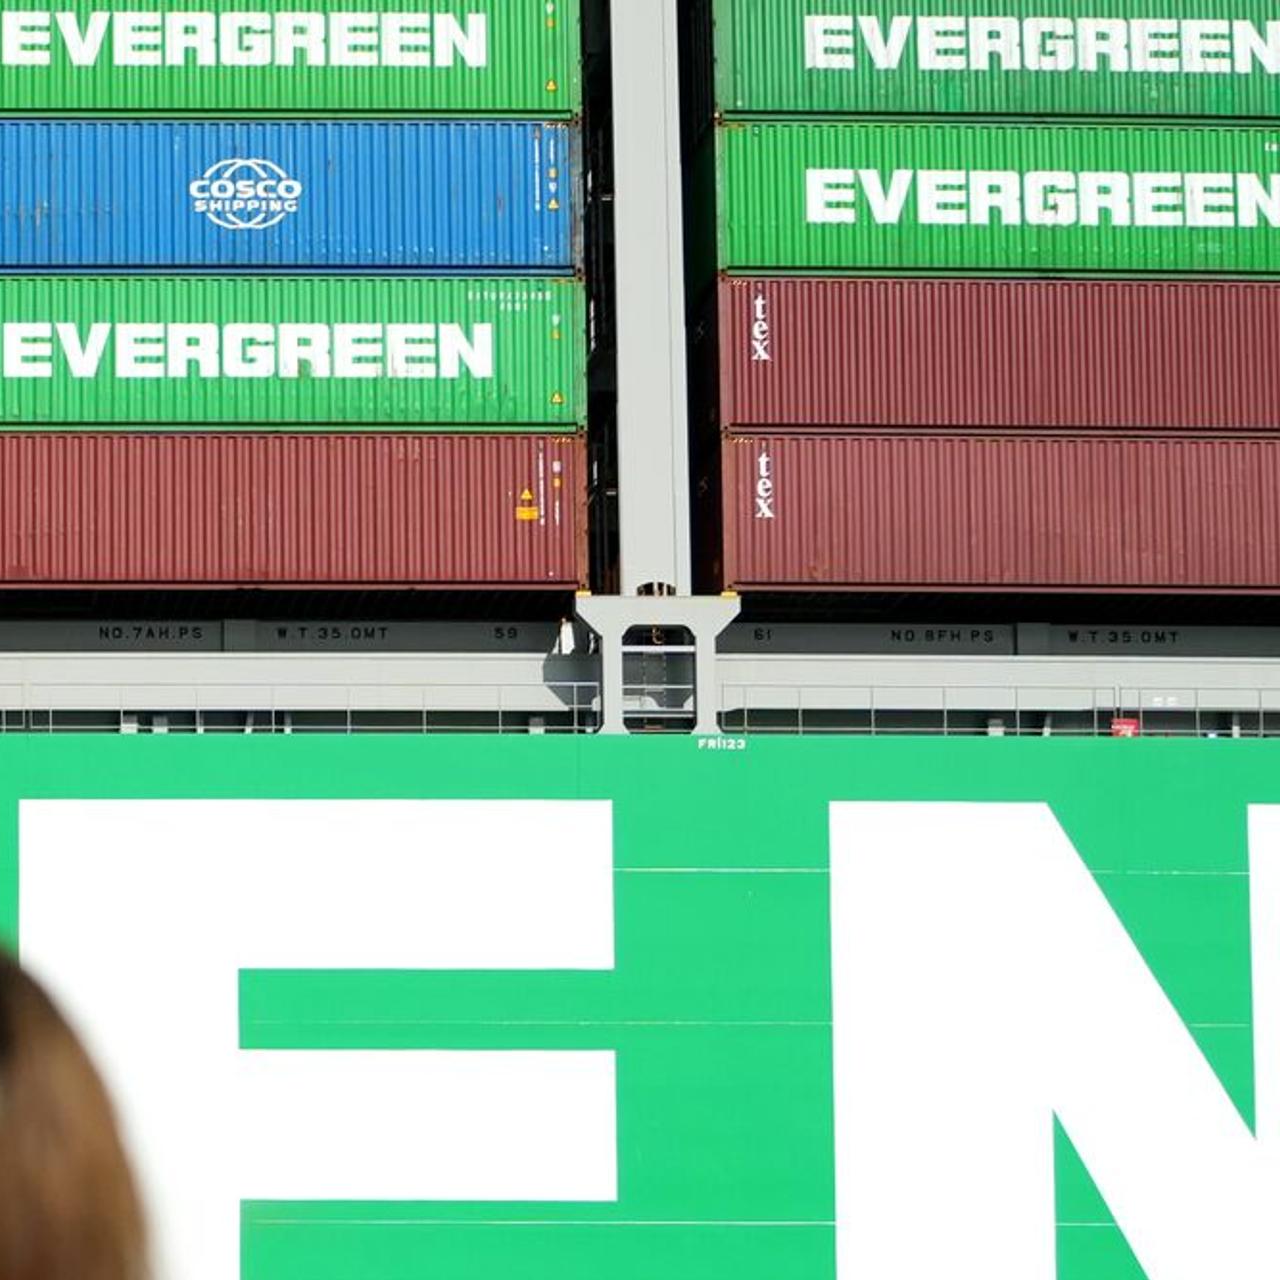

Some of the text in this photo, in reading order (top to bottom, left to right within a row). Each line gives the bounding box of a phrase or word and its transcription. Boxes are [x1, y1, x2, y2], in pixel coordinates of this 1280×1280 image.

[1, 11, 488, 68] EVERGREEN
[804, 14, 1280, 74] EVERGREEN
[189, 179, 303, 199] COSCO
[195, 199, 298, 212] SHIPPING
[805, 168, 1280, 228] EVERGREEN
[2, 322, 493, 379] EVERGREEN
[751, 294, 771, 361] tex
[755, 451, 775, 518] tex
[494, 626, 519, 640] 59
[753, 627, 772, 641] 61
